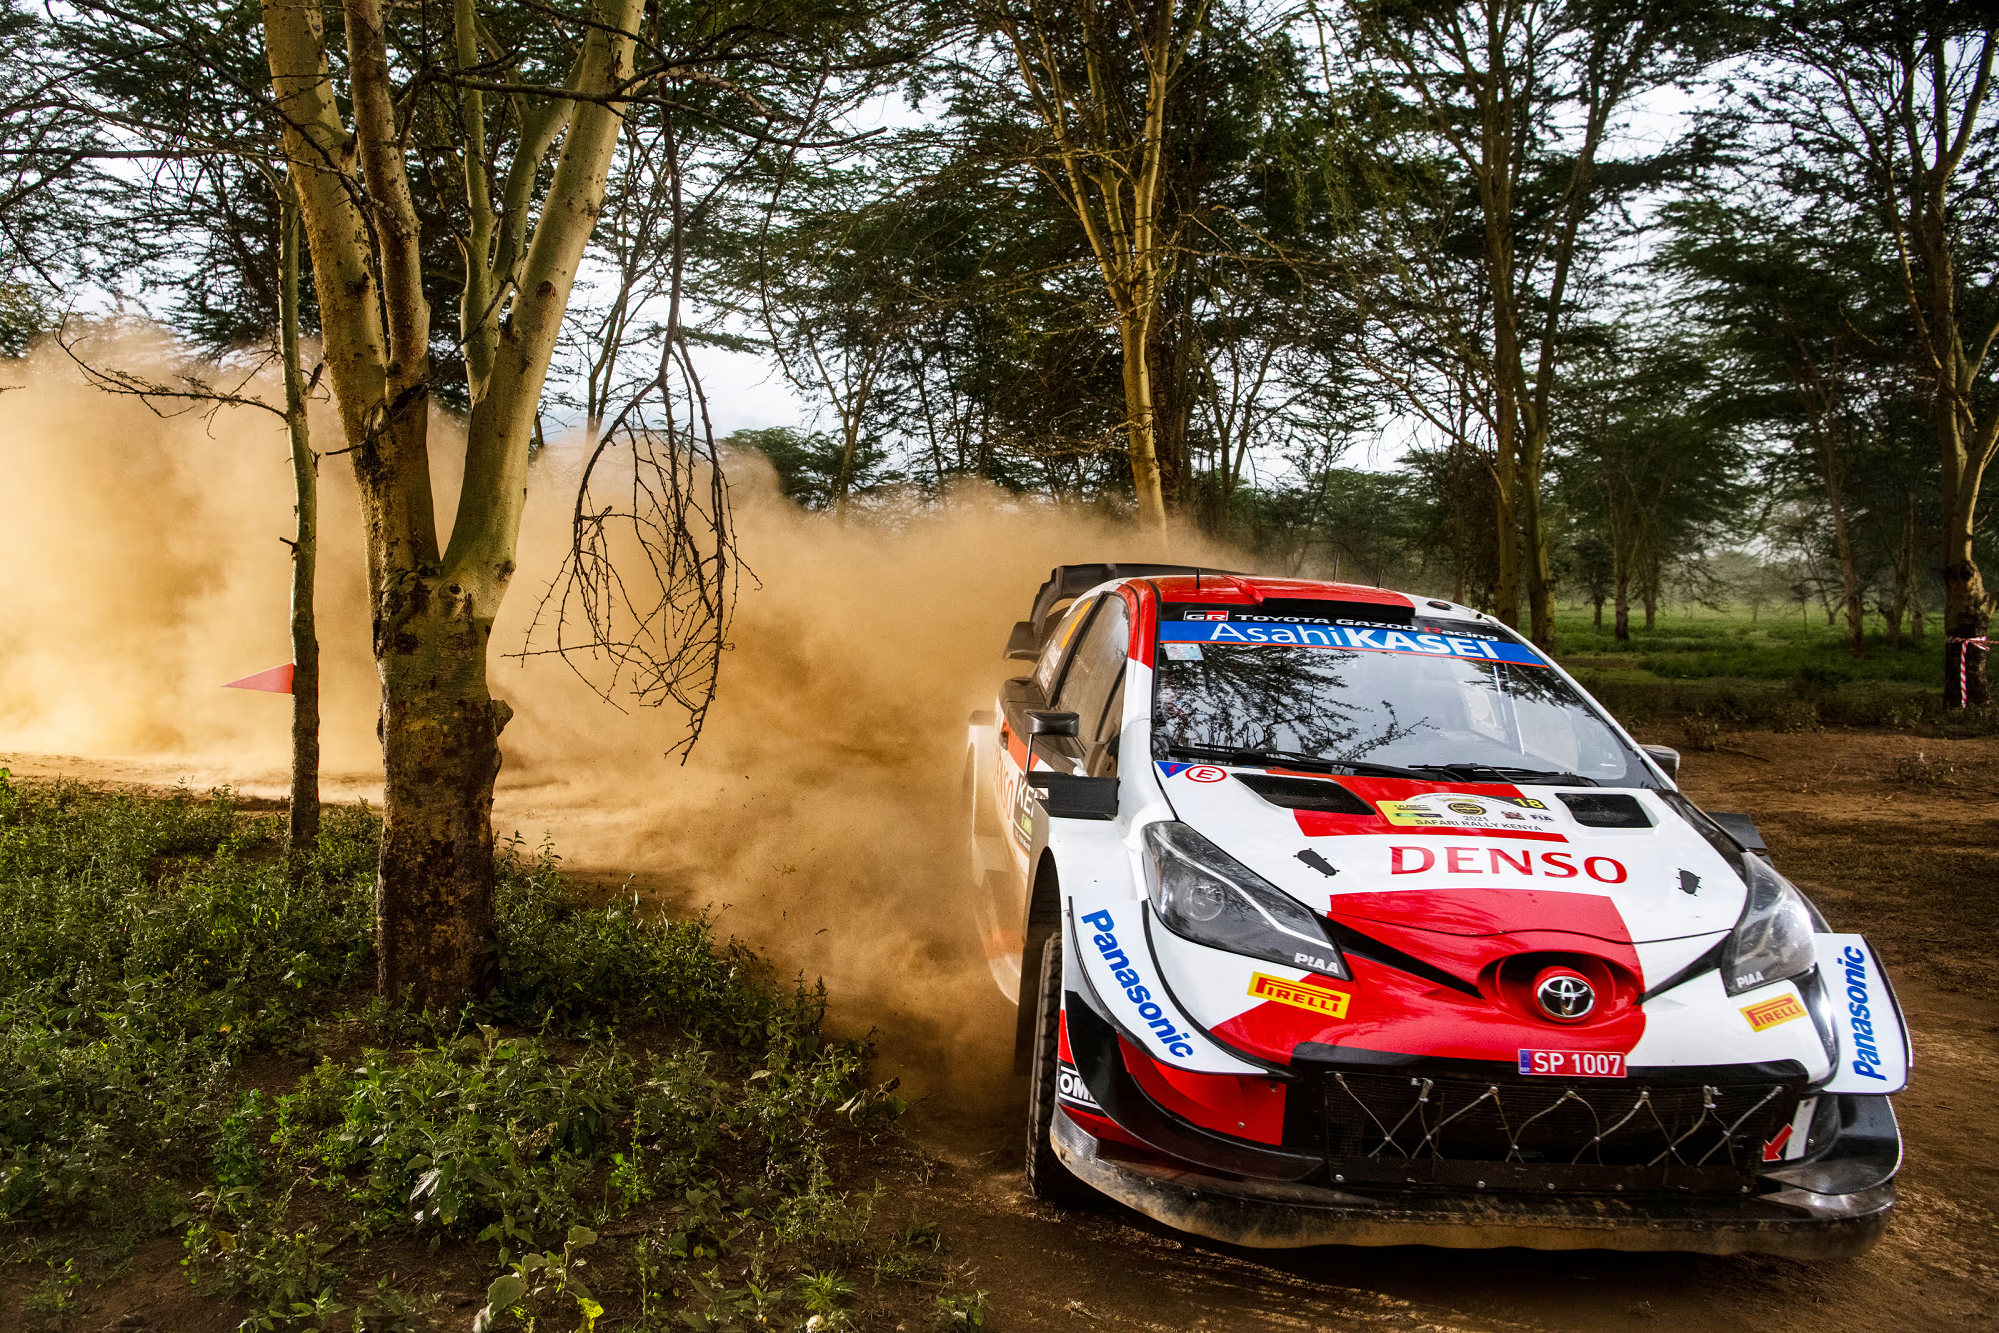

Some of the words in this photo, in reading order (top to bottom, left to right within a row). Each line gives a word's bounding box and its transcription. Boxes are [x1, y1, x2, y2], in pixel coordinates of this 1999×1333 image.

[1185, 612, 1227, 621] GR
[1235, 614, 1330, 624] TOYOTA
[1335, 618, 1418, 631] GAZOO
[1423, 626, 1499, 642] Racing
[1512, 798, 1545, 809] 18
[1461, 820, 1499, 828] RALLY
[1501, 823, 1544, 831] KENYA
[1388, 846, 1628, 884] DENSO
[1294, 952, 1339, 974] PIAA
[1081, 909, 1194, 1058] Panasonic
[1735, 971, 1765, 988] PIAA
[1255, 976, 1342, 1013] PIRELLI
[1745, 997, 1802, 1027] PIRELLI
[1837, 945, 1888, 1081] Panasonic
[1533, 1052, 1565, 1073] SP
[1571, 1053, 1621, 1075] 1007
[1059, 1073, 1096, 1101] OM
